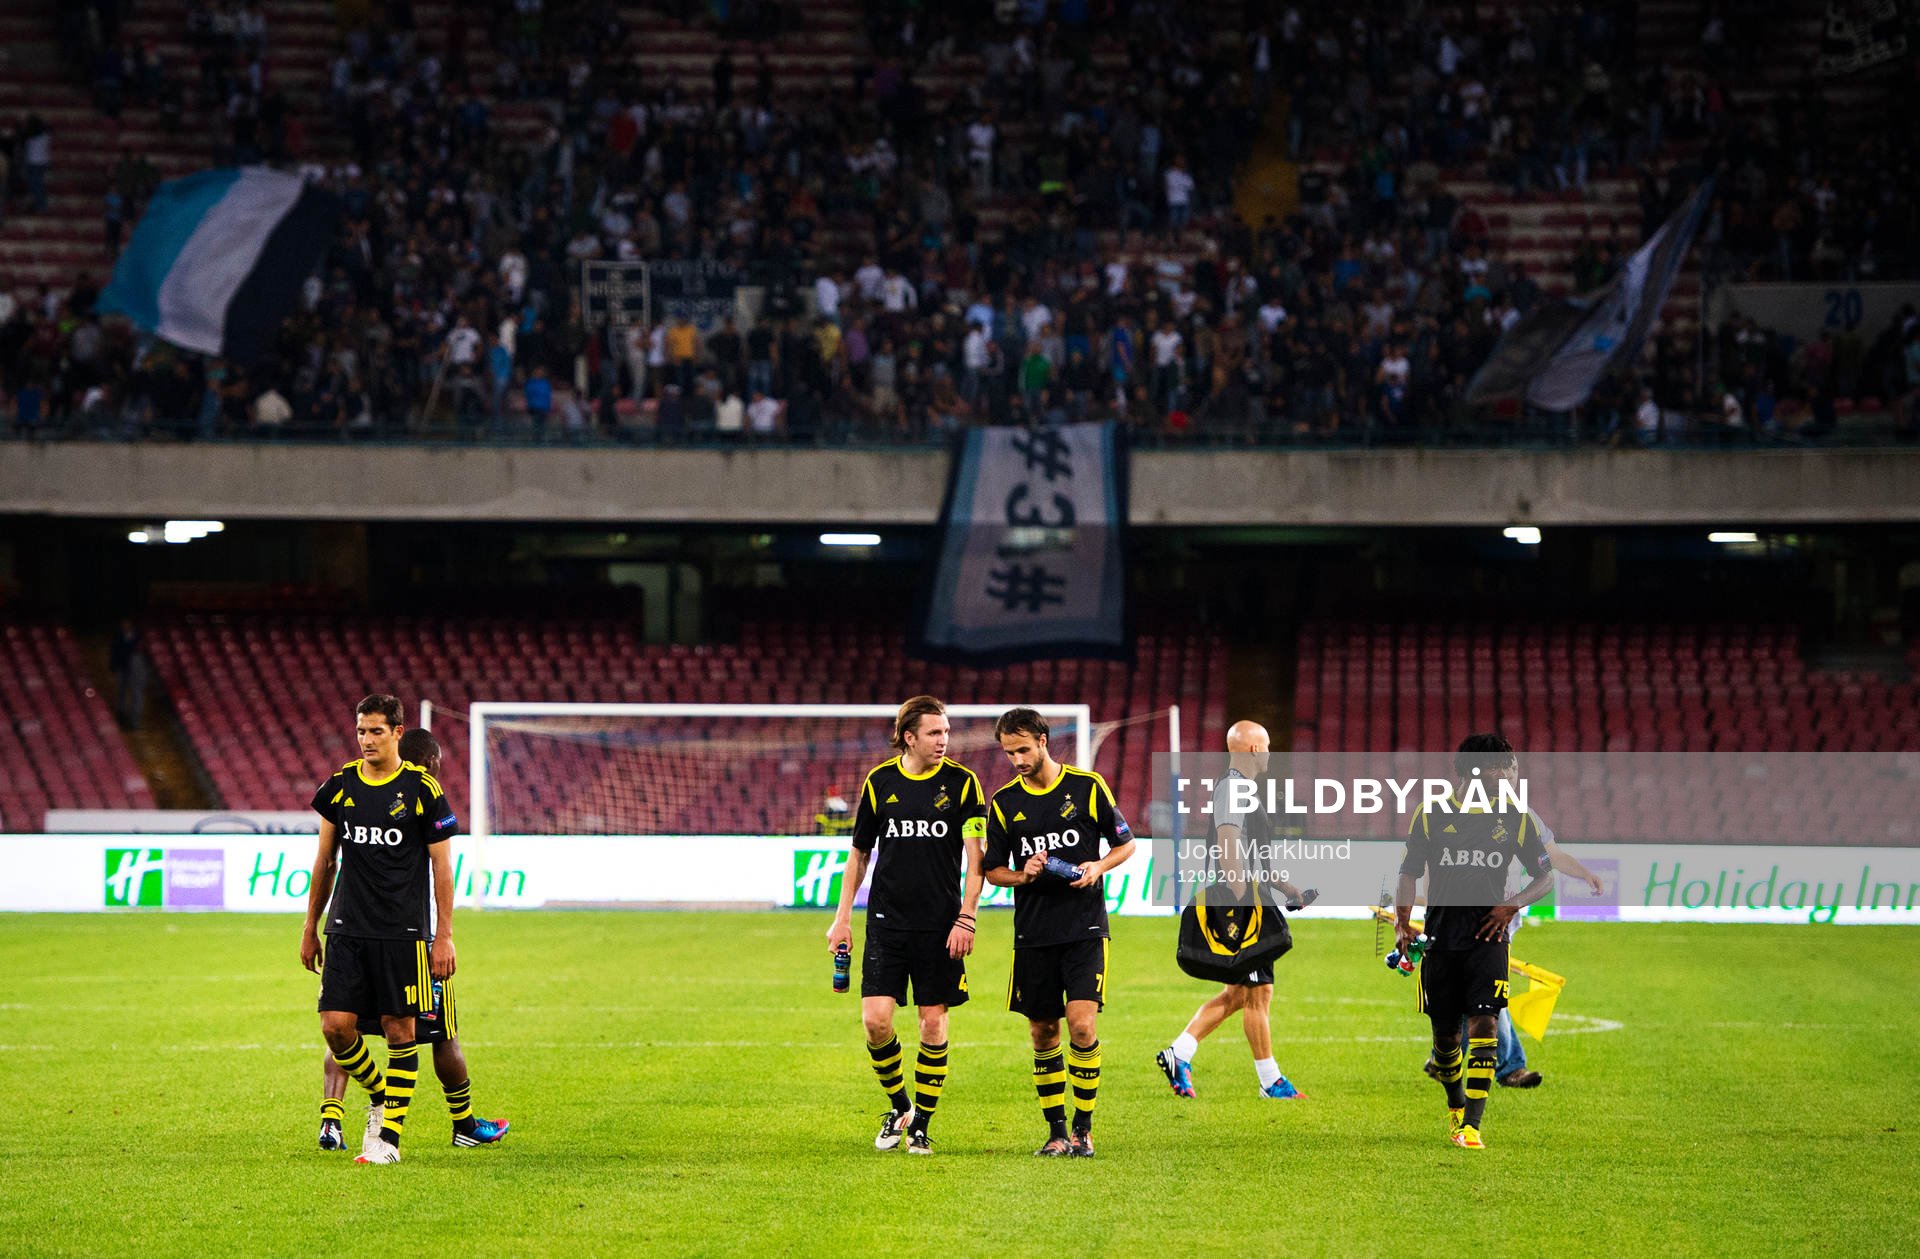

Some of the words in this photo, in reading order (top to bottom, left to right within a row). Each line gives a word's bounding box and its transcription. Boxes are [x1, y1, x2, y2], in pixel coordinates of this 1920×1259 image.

[1824, 289, 1863, 328] 20
[886, 819, 948, 838] ÅBRO
[1020, 829, 1080, 857] ÅBRO
[1440, 847, 1504, 868] ÅBRO
[1643, 862, 1843, 923] Holiday
[958, 974, 968, 992] 4
[1095, 974, 1103, 992] 7
[1494, 979, 1510, 999] 75
[404, 985, 417, 1005] 10
